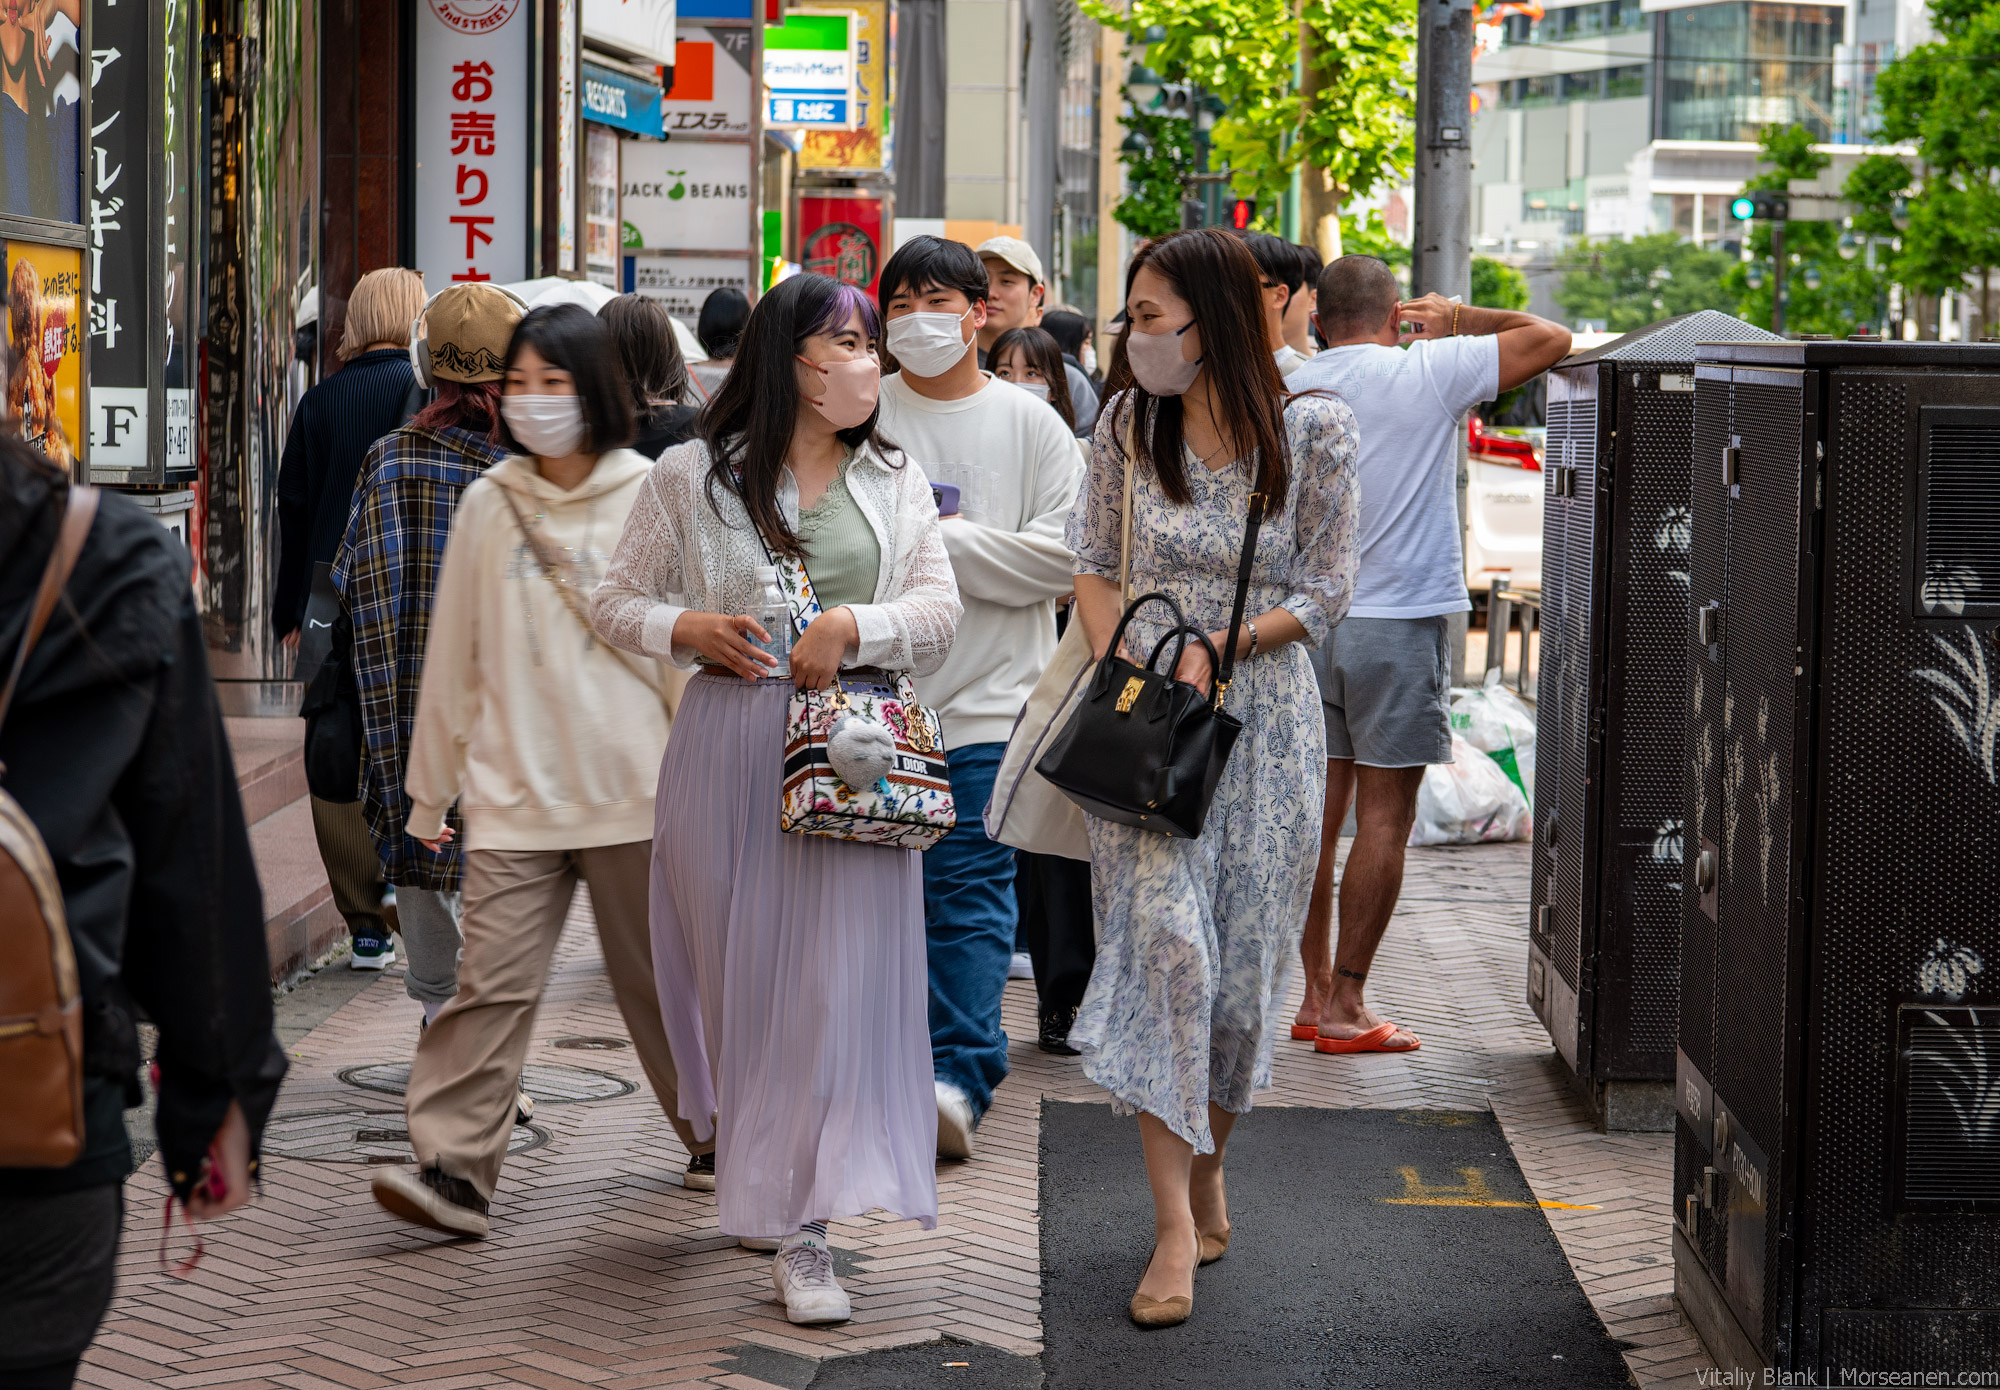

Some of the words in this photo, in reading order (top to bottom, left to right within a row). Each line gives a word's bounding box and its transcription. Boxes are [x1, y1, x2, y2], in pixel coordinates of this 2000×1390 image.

[461, 4, 509, 30] STREET
[724, 33, 749, 51] 7F
[764, 62, 844, 76] FamilyMart
[622, 182, 663, 197] JACK
[690, 183, 748, 199] BEANS
[902, 757, 928, 775] DIOR
